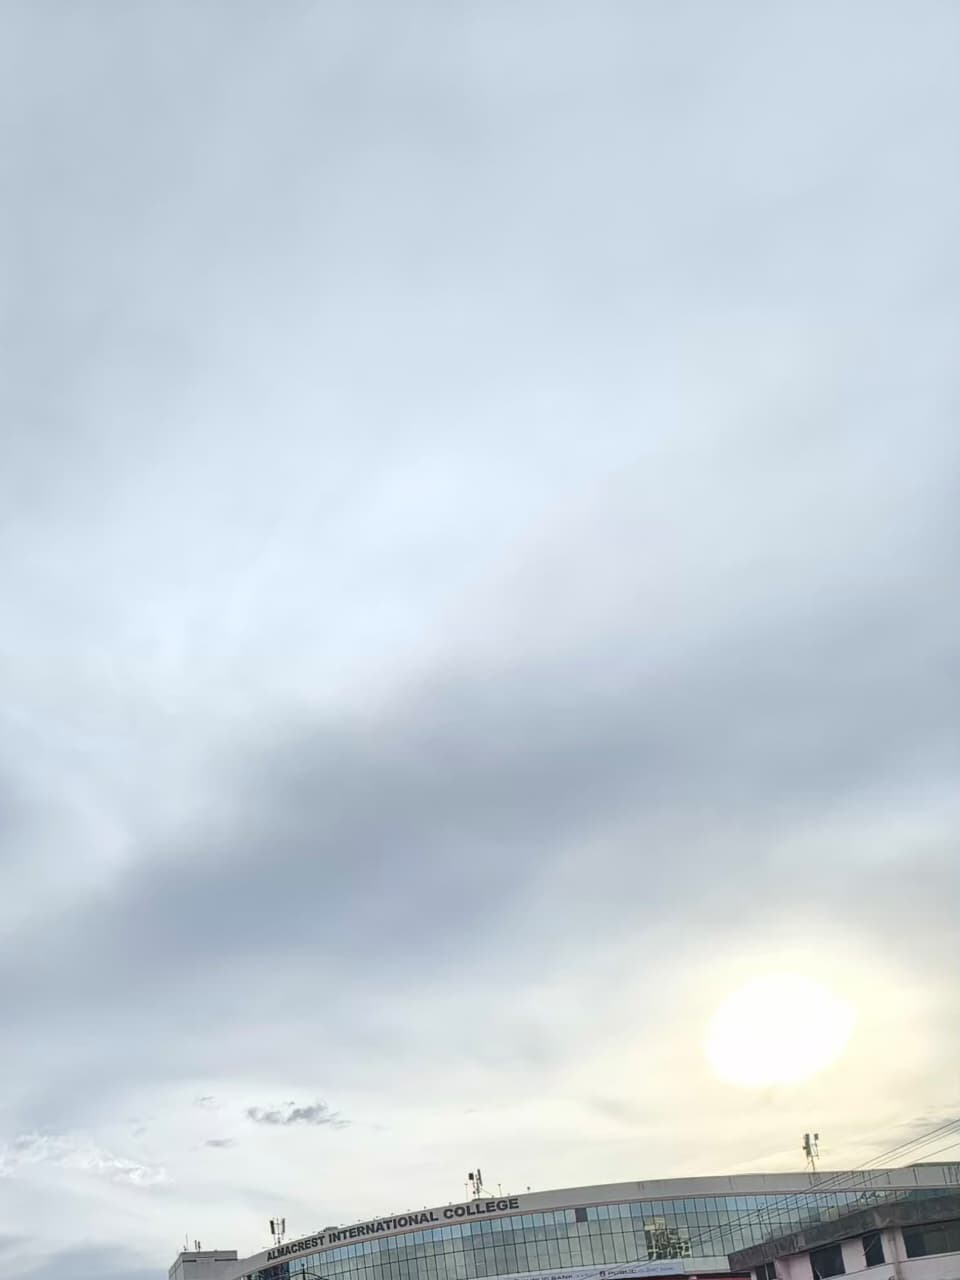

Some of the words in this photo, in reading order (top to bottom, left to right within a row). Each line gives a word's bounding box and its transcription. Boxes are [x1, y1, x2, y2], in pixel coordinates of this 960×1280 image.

[267, 1236, 325, 1262] ALMACREST
[328, 1211, 439, 1243] INTERNATIONAL
[443, 1198, 519, 1219] COLLEGE
